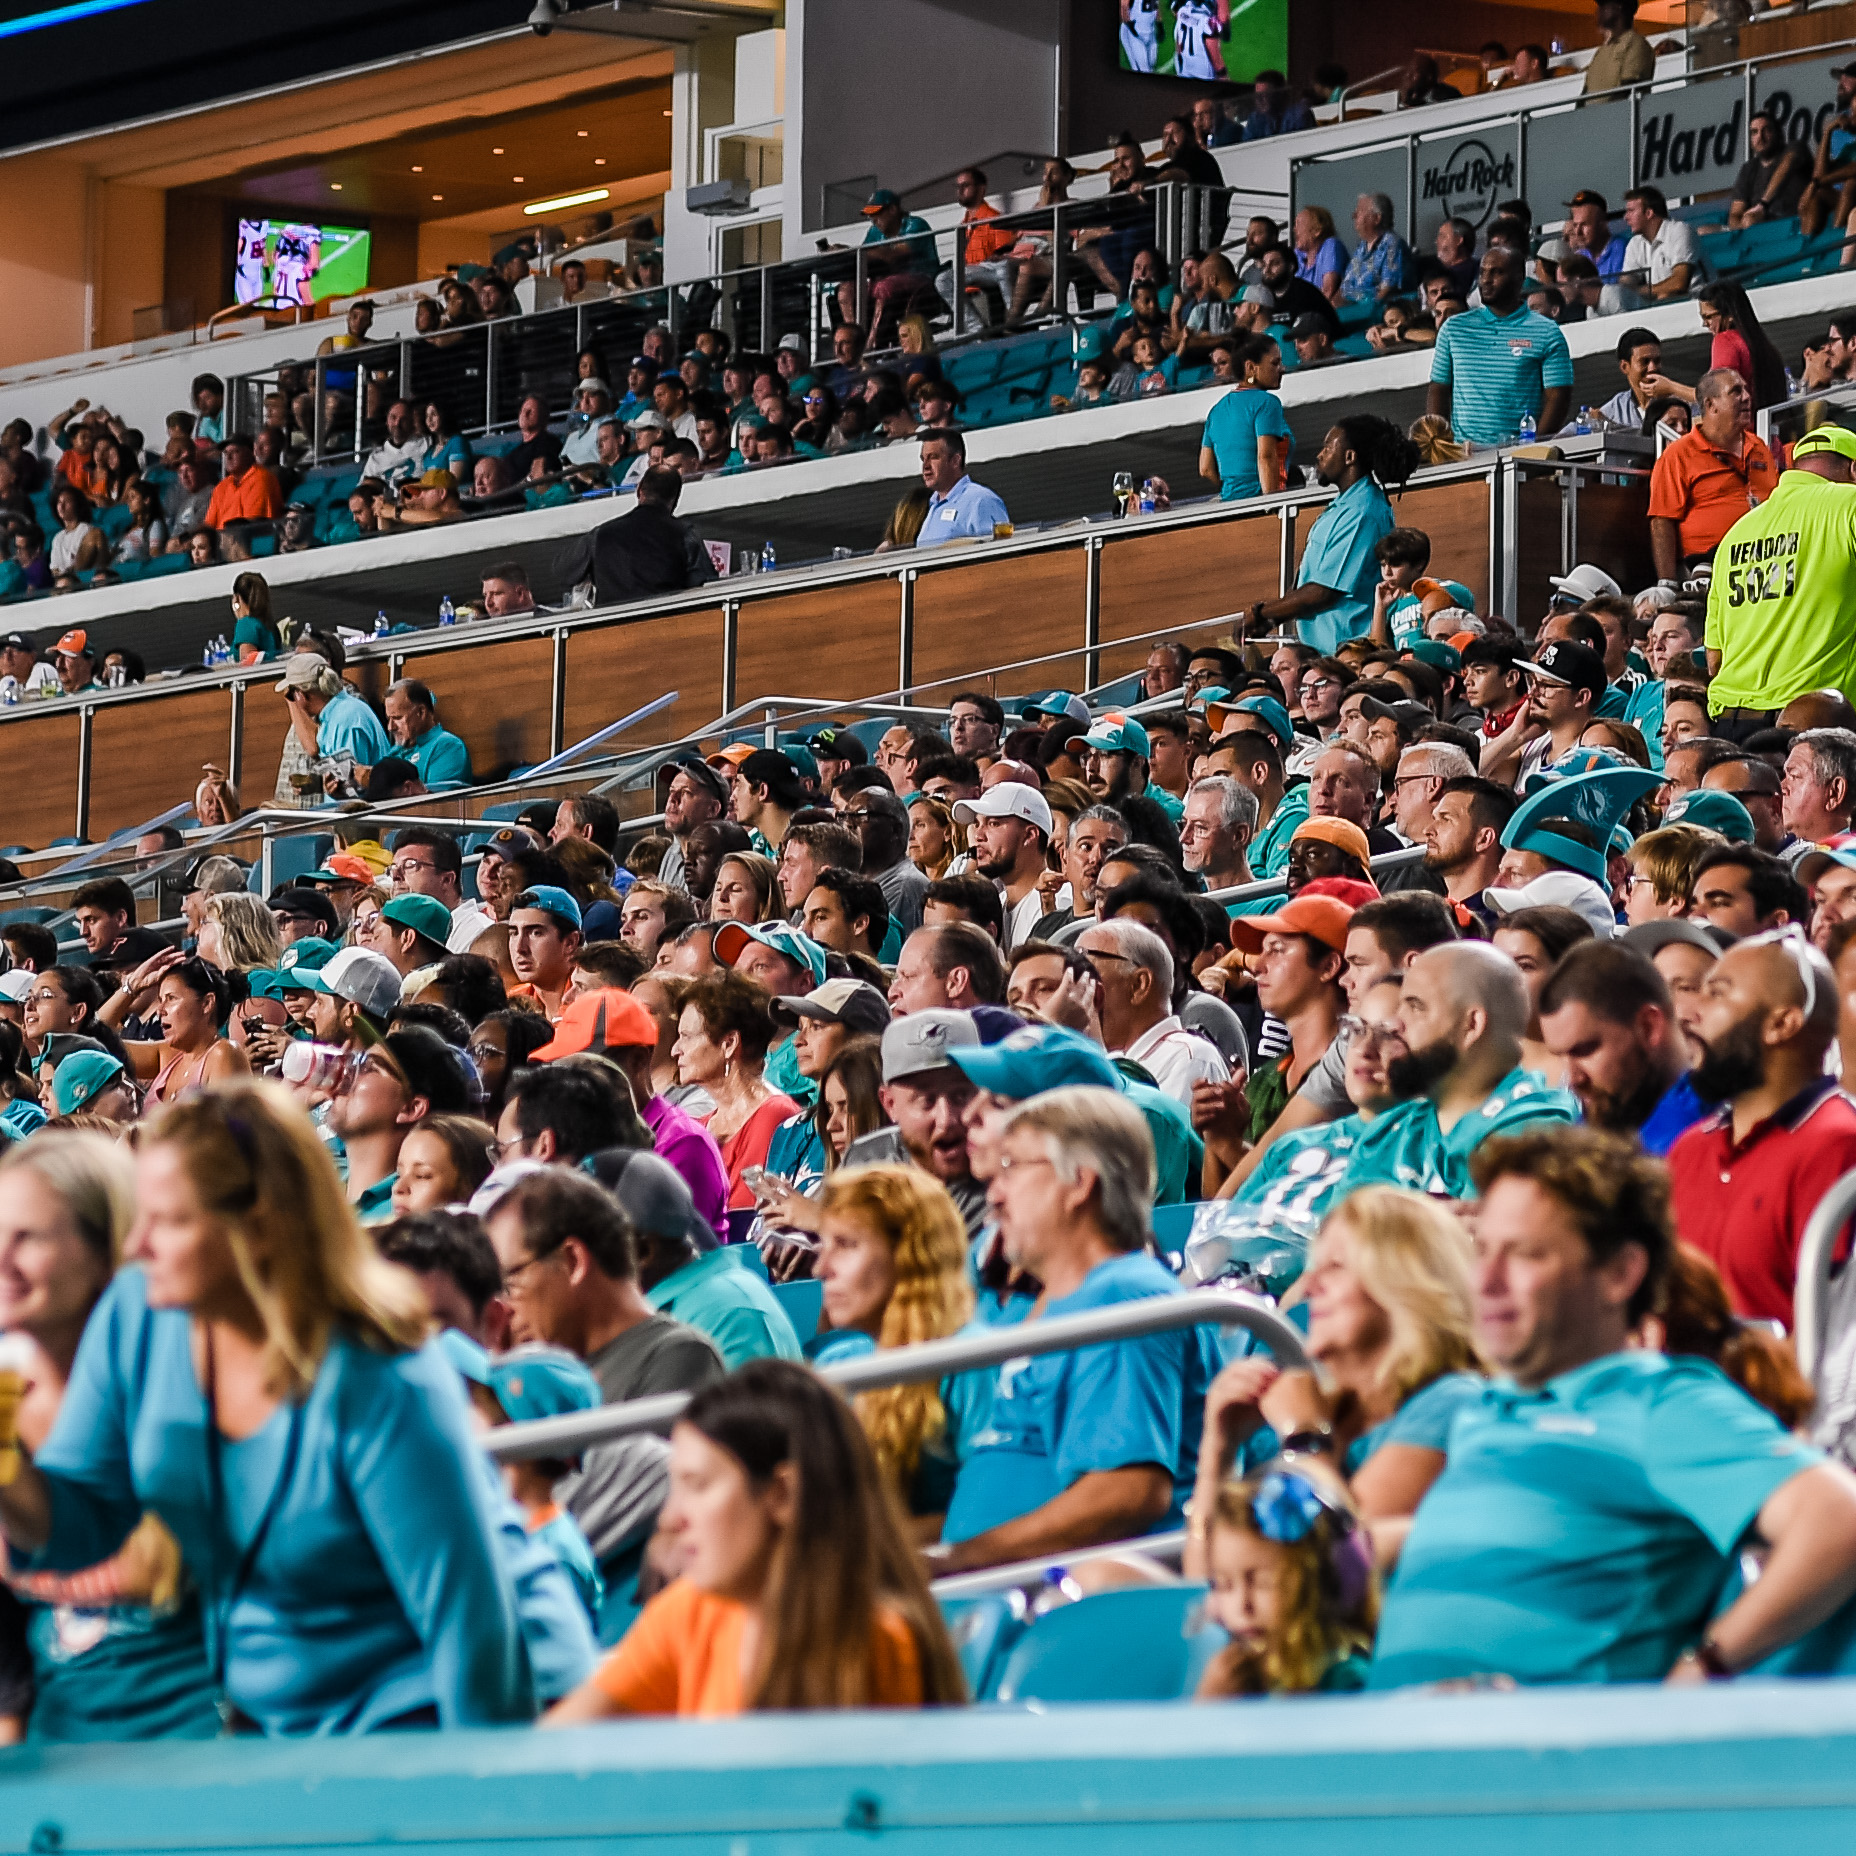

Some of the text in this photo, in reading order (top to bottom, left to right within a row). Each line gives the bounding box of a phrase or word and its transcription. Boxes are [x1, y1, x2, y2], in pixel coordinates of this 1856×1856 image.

[1643, 99, 1744, 181] Hard
[1763, 90, 1837, 145] Roc
[1422, 151, 1515, 200] Hard Rock
[1730, 531, 1799, 567] VENDOR
